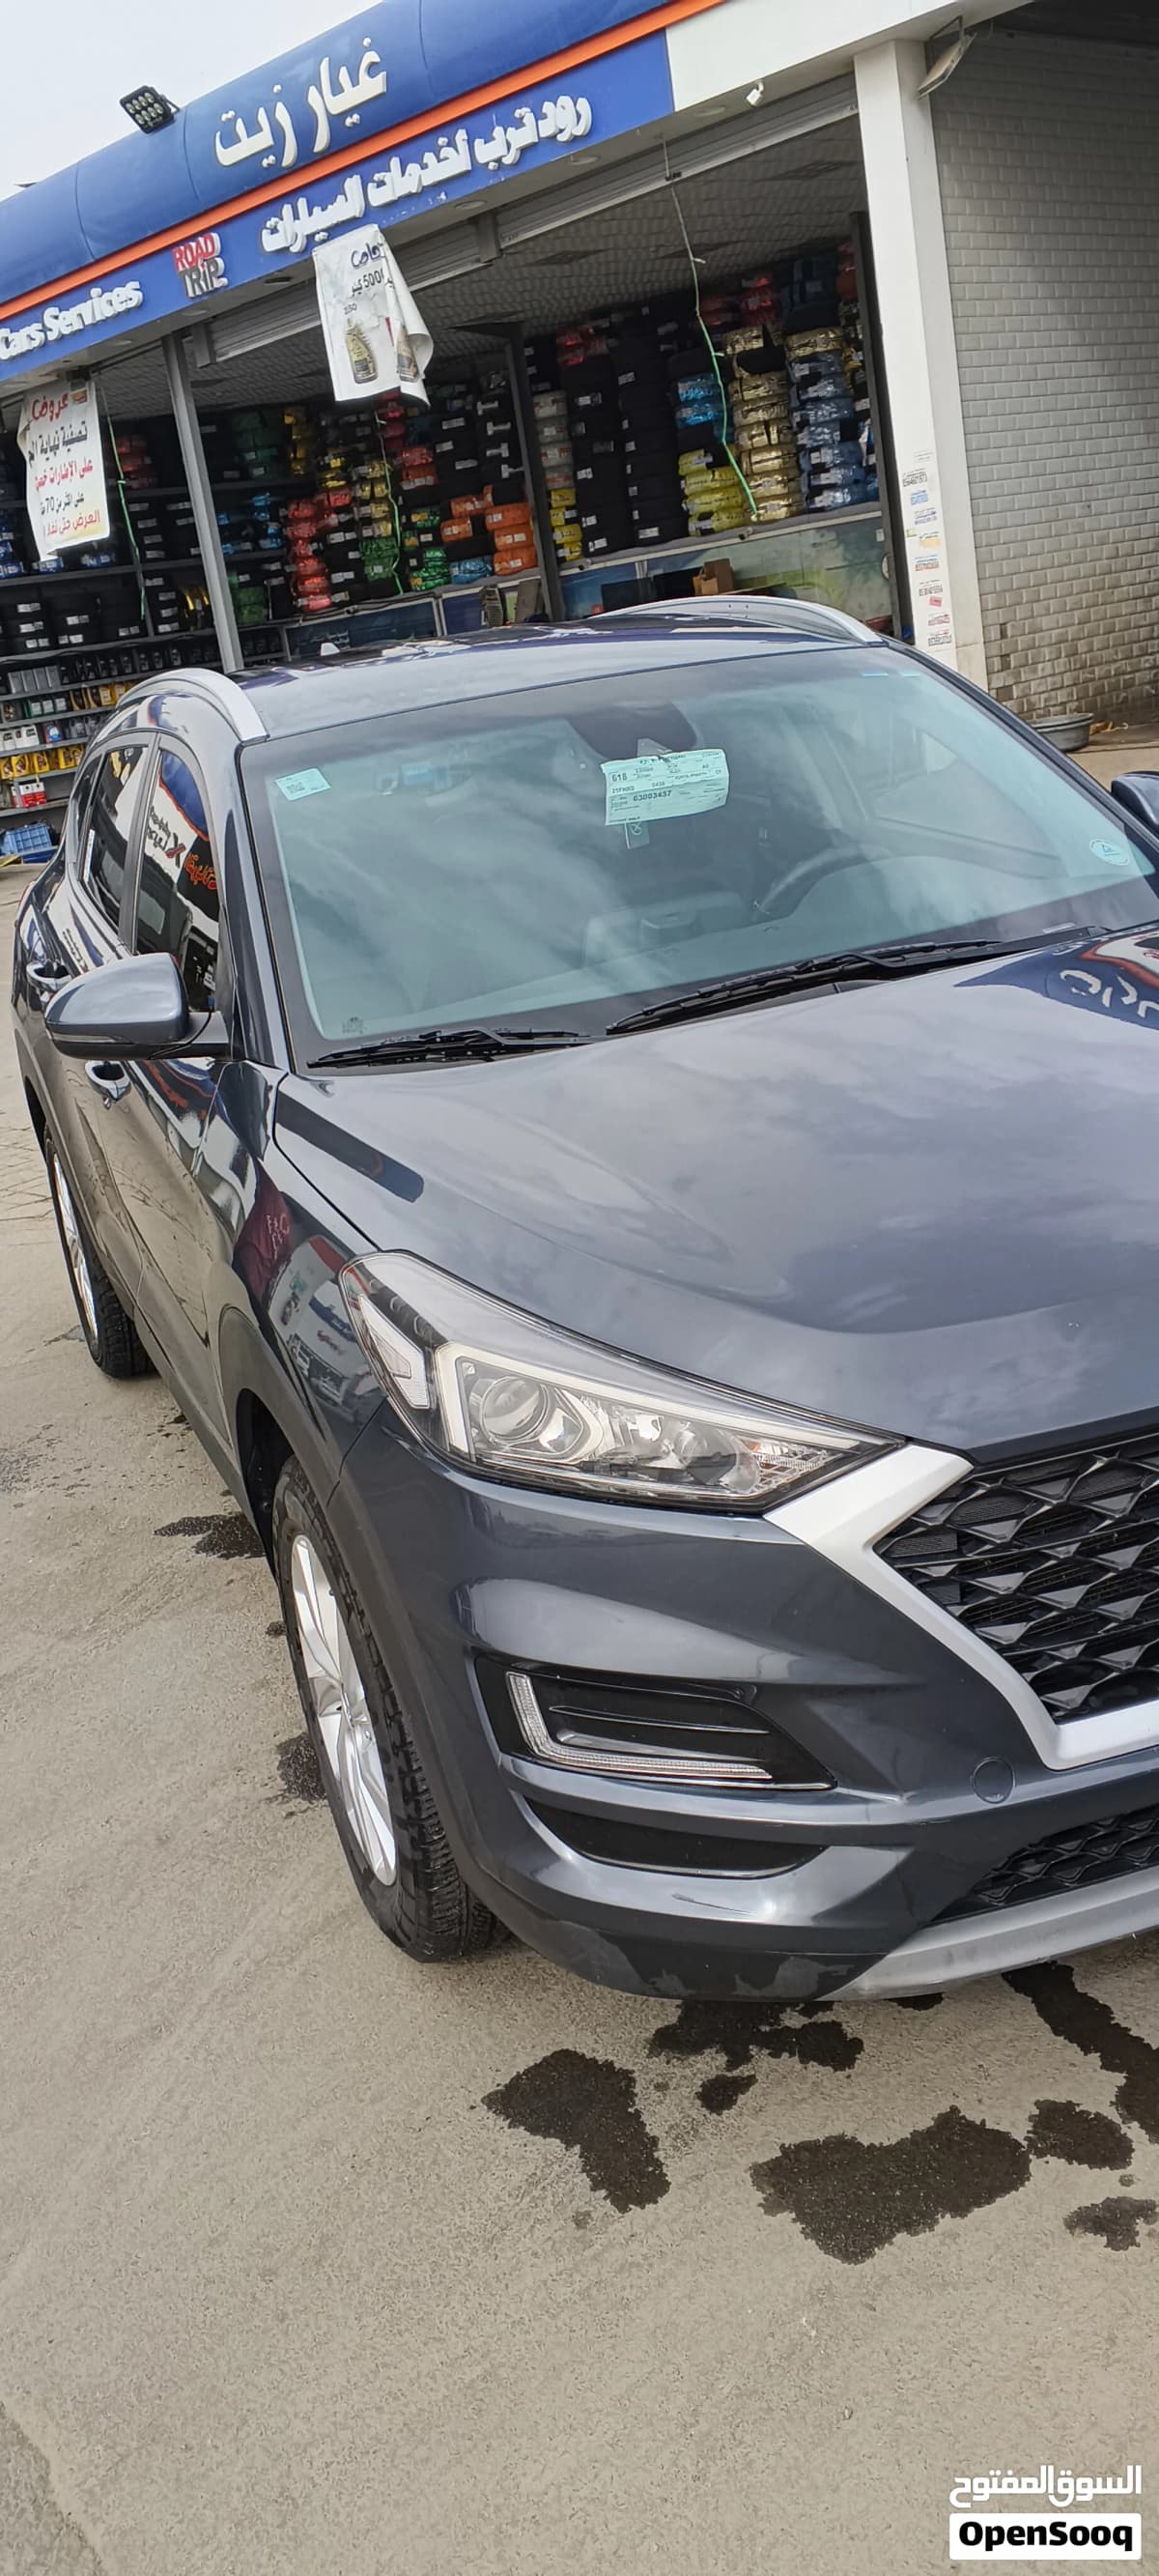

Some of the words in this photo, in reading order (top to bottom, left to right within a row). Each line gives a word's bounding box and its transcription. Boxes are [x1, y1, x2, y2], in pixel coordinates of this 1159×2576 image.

[214, 84, 297, 169] زيت
[307, 37, 387, 154] غيار
[538, 95, 592, 142] رود
[367, 129, 472, 207] لخدمات
[473, 106, 539, 170] ترب
[260, 175, 366, 253] السيارات
[172, 232, 221, 272] ROAD
[0, 321, 45, 360] Cars
[42, 280, 144, 341] Services
[31, 391, 69, 422] عروض
[73, 509, 101, 531] العرض
